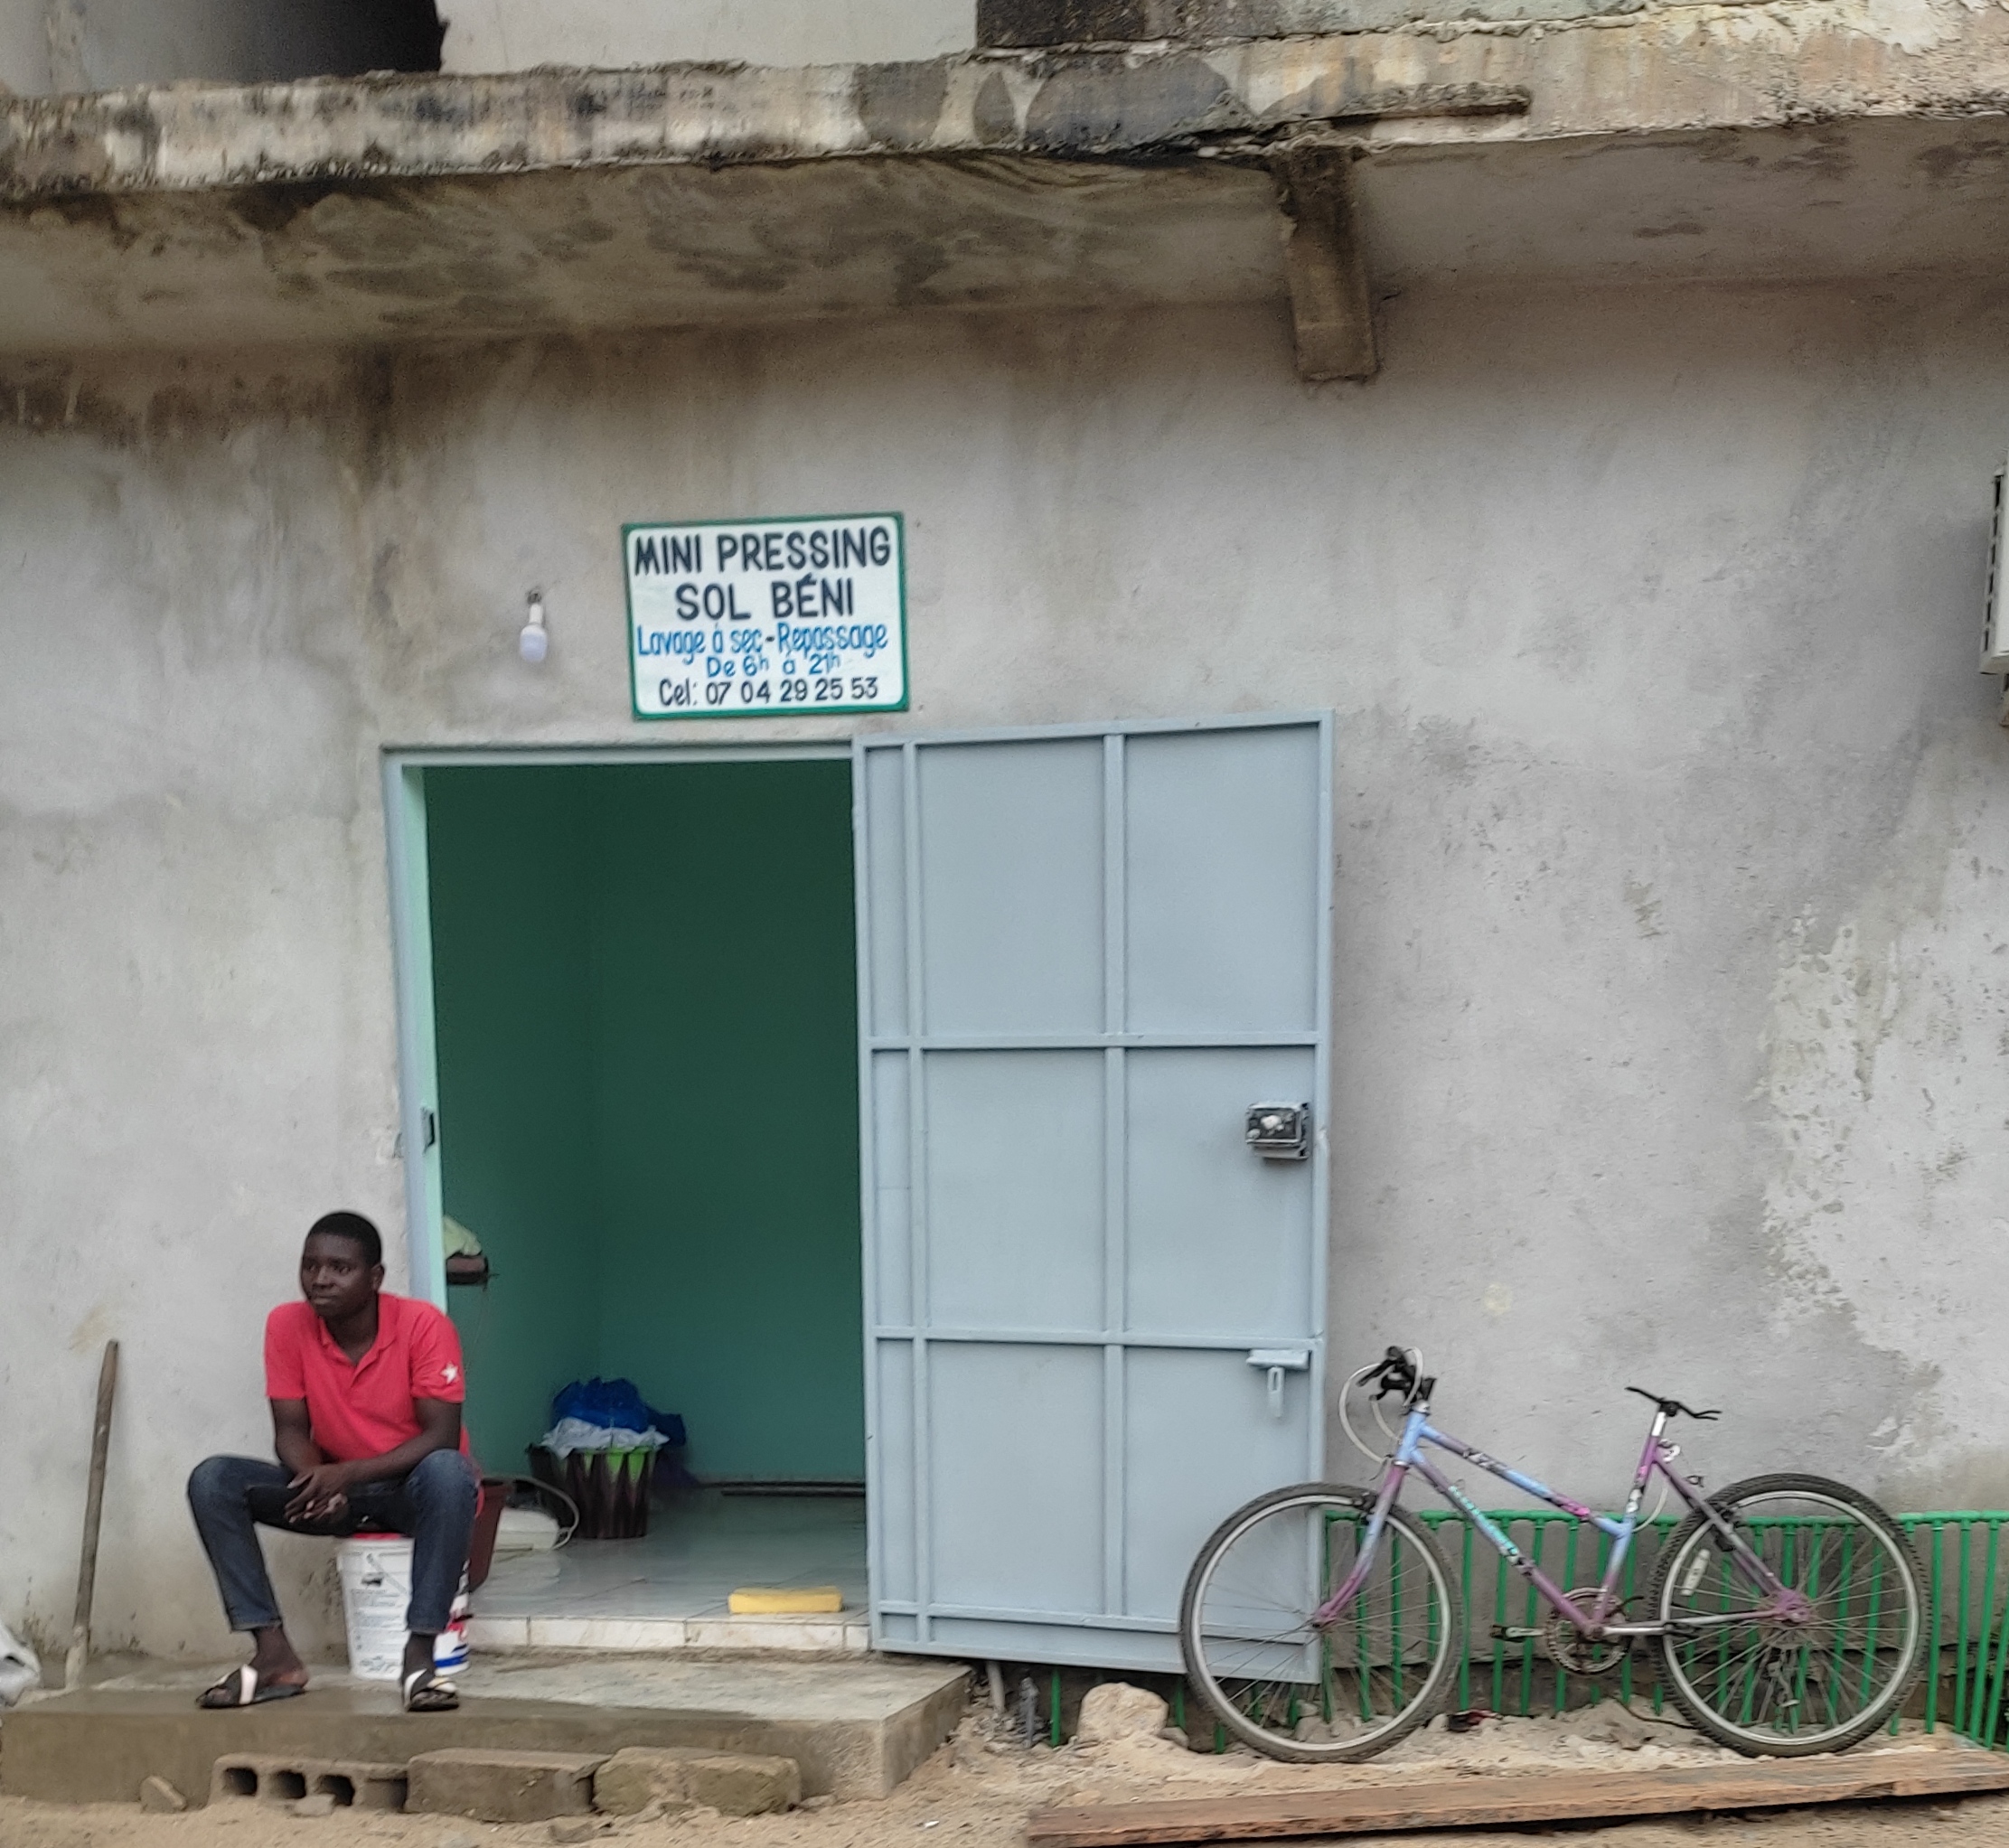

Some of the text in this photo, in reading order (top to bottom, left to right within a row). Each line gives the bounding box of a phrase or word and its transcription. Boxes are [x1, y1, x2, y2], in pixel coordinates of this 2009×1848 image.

[634, 526, 891, 576] MINI PRESSING
[675, 573, 853, 621] SOL BÉNI
[637, 625, 706, 664] Lavage
[707, 656, 736, 677] De
[809, 651, 840, 675] 21h
[660, 677, 878, 706] Cel: 07 04 29 25 53
